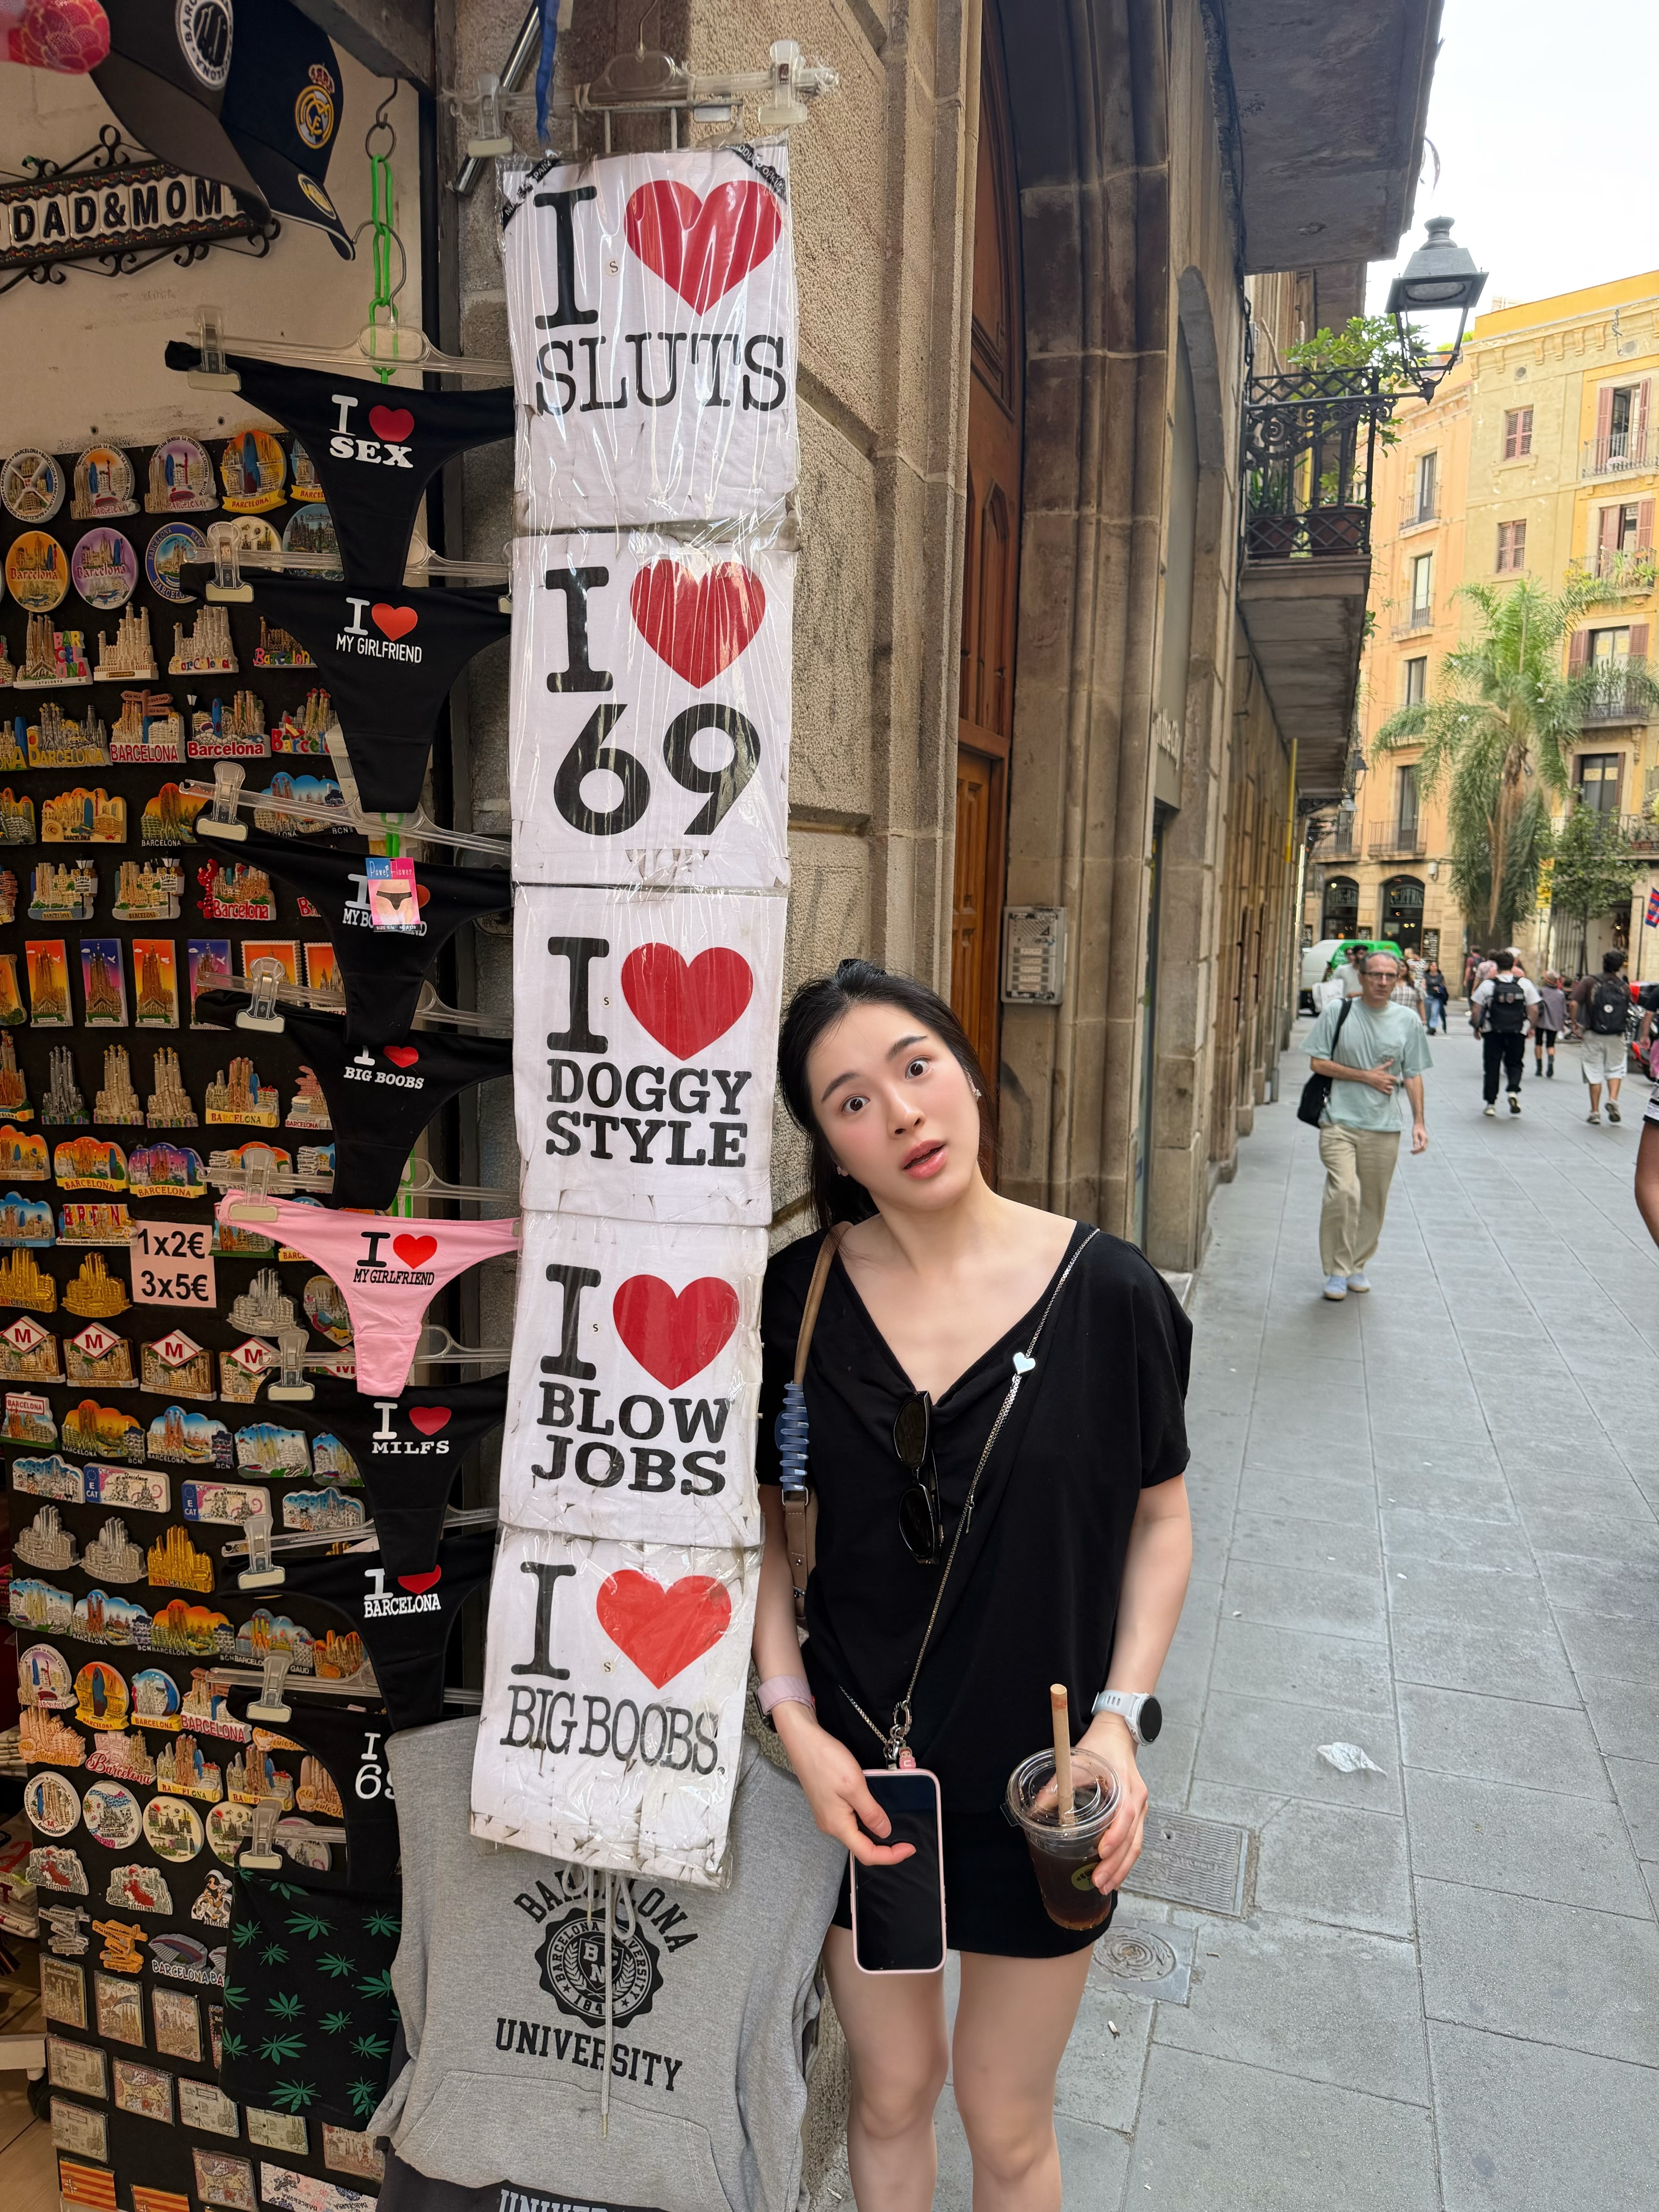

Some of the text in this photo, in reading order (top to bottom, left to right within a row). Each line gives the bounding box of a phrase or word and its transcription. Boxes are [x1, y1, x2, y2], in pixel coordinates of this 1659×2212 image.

[533, 186, 598, 329] I
[609, 261, 619, 274] S
[535, 332, 787, 417] SLUTS
[330, 394, 358, 436] I
[329, 436, 414, 468] SEX
[232, 497, 269, 508] BARCELONA
[300, 490, 324, 498] BARCEL
[148, 527, 173, 561] BARCELONA
[10, 563, 58, 581] Barcelona
[76, 563, 126, 579] Barcelona
[153, 579, 186, 599] BARCELO
[344, 597, 370, 636] I
[545, 565, 613, 693] I
[336, 633, 422, 664] MY GIRLFRIEND
[110, 744, 179, 762] BARCELONA
[188, 742, 264, 757] Barcelona
[554, 703, 761, 836] 69
[213, 899, 269, 919] Barcelona
[342, 908, 361, 926] MY
[547, 936, 610, 1054] I
[604, 996, 610, 1006] S
[343, 1067, 424, 1090] BIG BOOBS
[546, 1058, 752, 1116] DOGGY
[211, 1113, 261, 1125] BARCELONA
[286, 1120, 319, 1129] BARCELONA
[545, 1110, 748, 1168] STYLE
[65, 1179, 115, 1191] BARCELONA
[138, 1186, 192, 1197] BARCELONA
[138, 1229, 206, 1259] 1x2€
[356, 1231, 391, 1268] I
[141, 1270, 209, 1301] 3x5€
[353, 1268, 370, 1284] MY
[370, 1269, 435, 1286] GIRLFRIEND
[540, 1263, 602, 1381] I
[593, 1323, 599, 1332] S
[15, 1328, 32, 1344] M
[85, 1334, 103, 1350] M
[165, 1341, 184, 1359] M
[8, 1399, 43, 1411] BARCELONA
[536, 1381, 736, 1444] BLOW
[373, 1402, 398, 1440] I
[62, 1445, 98, 1457] BARCELONA
[372, 1440, 450, 1454] MILFS
[147, 1453, 186, 1464] BARCELONA
[531, 1434, 726, 1497] JOBS
[86, 1489, 99, 1499] CAT
[187, 1499, 193, 1507] E
[185, 1508, 197, 1516] CAT
[153, 1576, 199, 1590] BARCELONA
[364, 1568, 394, 1601] I
[363, 1593, 442, 1618] BARCELONA
[511, 1560, 577, 1681] I
[73, 1633, 108, 1645] BARCELONA
[152, 1645, 190, 1656] BARCELONA
[234, 1655, 264, 1667] BARCELO
[604, 1662, 611, 1673] S
[134, 1717, 173, 1729] BARCELONA
[180, 1714, 245, 1743] BARCELONA
[361, 1732, 381, 1761] I
[86, 1753, 152, 1785] Barcelona
[162, 1783, 207, 1800] BARCELONA
[204, 1917, 229, 1929] Madri
[552, 1921, 648, 2000] BARCELONA VERSITY
[152, 1960, 208, 1985] BARCELONA
[495, 2017, 683, 2092] UNIVERSITY
